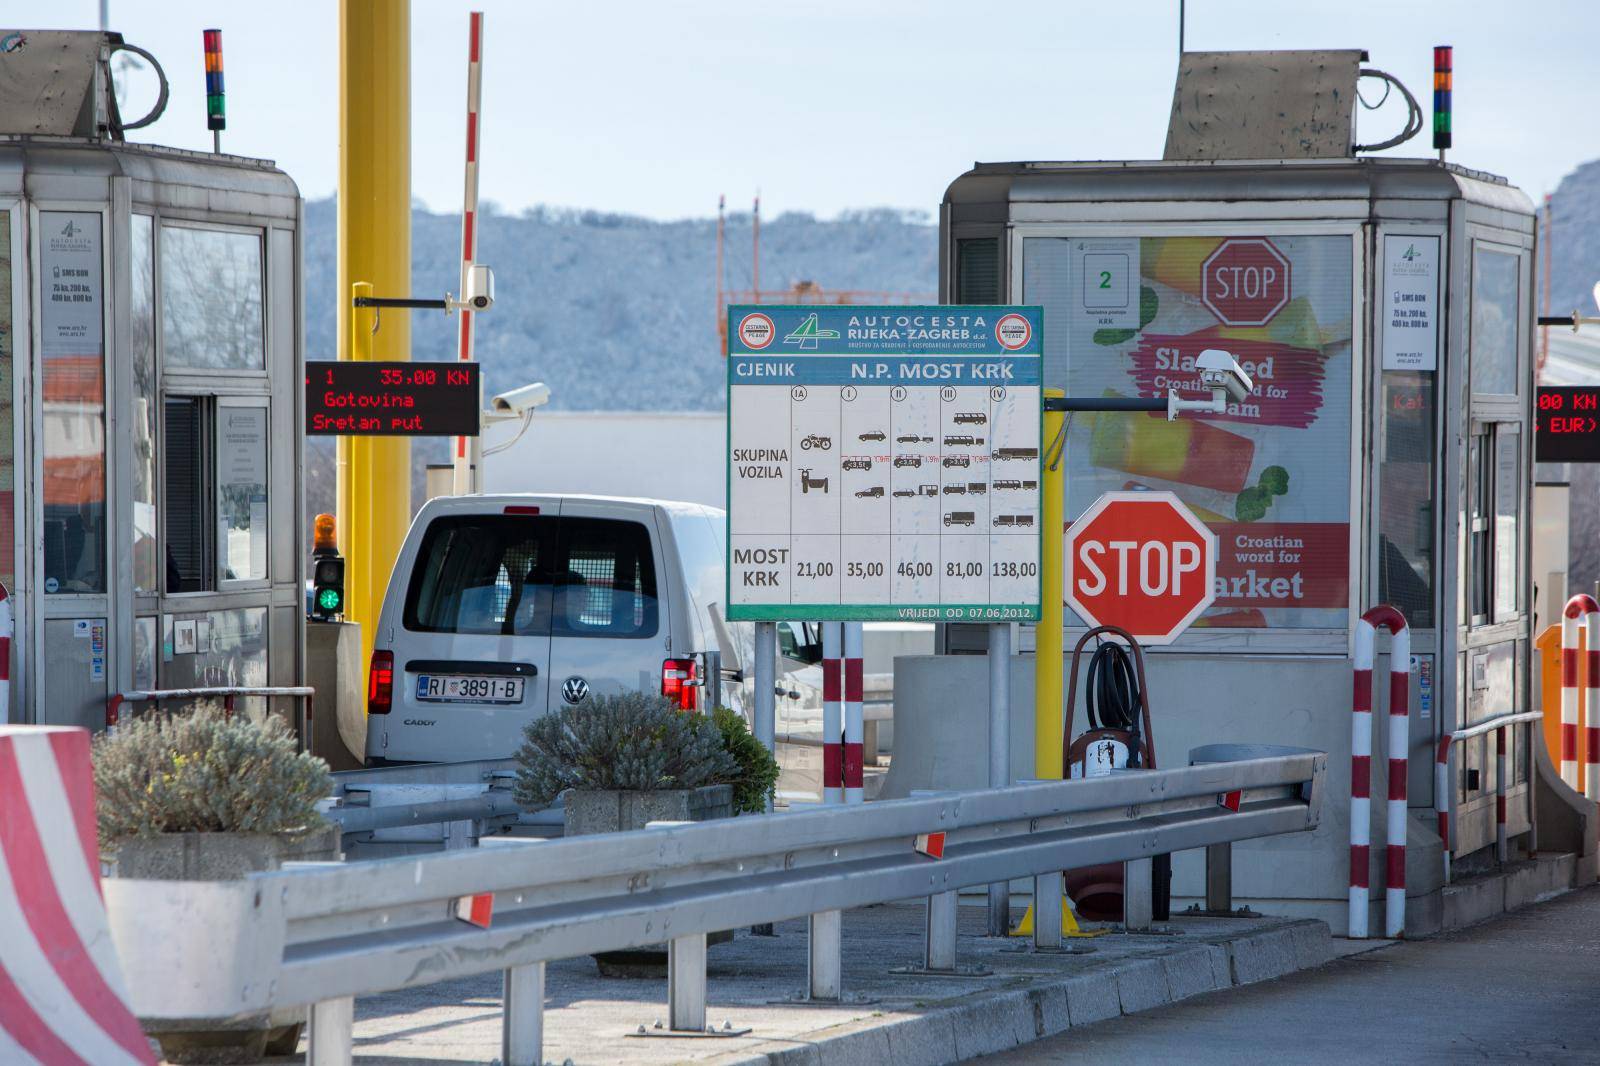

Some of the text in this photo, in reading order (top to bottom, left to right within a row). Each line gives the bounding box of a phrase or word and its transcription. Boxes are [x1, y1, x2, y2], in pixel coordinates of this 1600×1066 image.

[1100, 271, 1111, 289] 2
[1216, 266, 1276, 299] STOP
[848, 316, 986, 327] AUTOCESTA
[847, 329, 970, 340] RIJEKA-ZAGREB
[736, 363, 795, 377] CJENIK
[851, 363, 1014, 379] N.P. MOST KRK
[1155, 348, 1274, 379] Slaed
[326, 370, 334, 384] 1
[447, 371, 469, 385] KN
[324, 392, 415, 408] Gotovina
[944, 389, 953, 398] III
[993, 389, 1003, 398] IV
[1266, 385, 1289, 399] for
[1573, 394, 1597, 410] KN
[313, 414, 423, 430] Sretan put
[1551, 417, 1597, 433] EUR)
[733, 449, 788, 462] SKUPINA
[739, 466, 783, 479] VOZILA
[1235, 535, 1304, 548] Croatian
[734, 549, 789, 564] MOST
[1235, 550, 1301, 563] word for
[797, 562, 833, 578] 21,00
[847, 562, 884, 578] 35,00
[897, 562, 933, 578] 46,00
[946, 562, 983, 578] 81,00
[993, 562, 1037, 578] 138,00
[1078, 540, 1201, 597] STOP
[743, 571, 779, 586] KRK
[1215, 569, 1304, 598] arket
[898, 608, 1034, 619] VRIJEDI OD 07.06.2012.
[429, 679, 515, 697] RI 3891-B
[562, 677, 590, 702] VW
